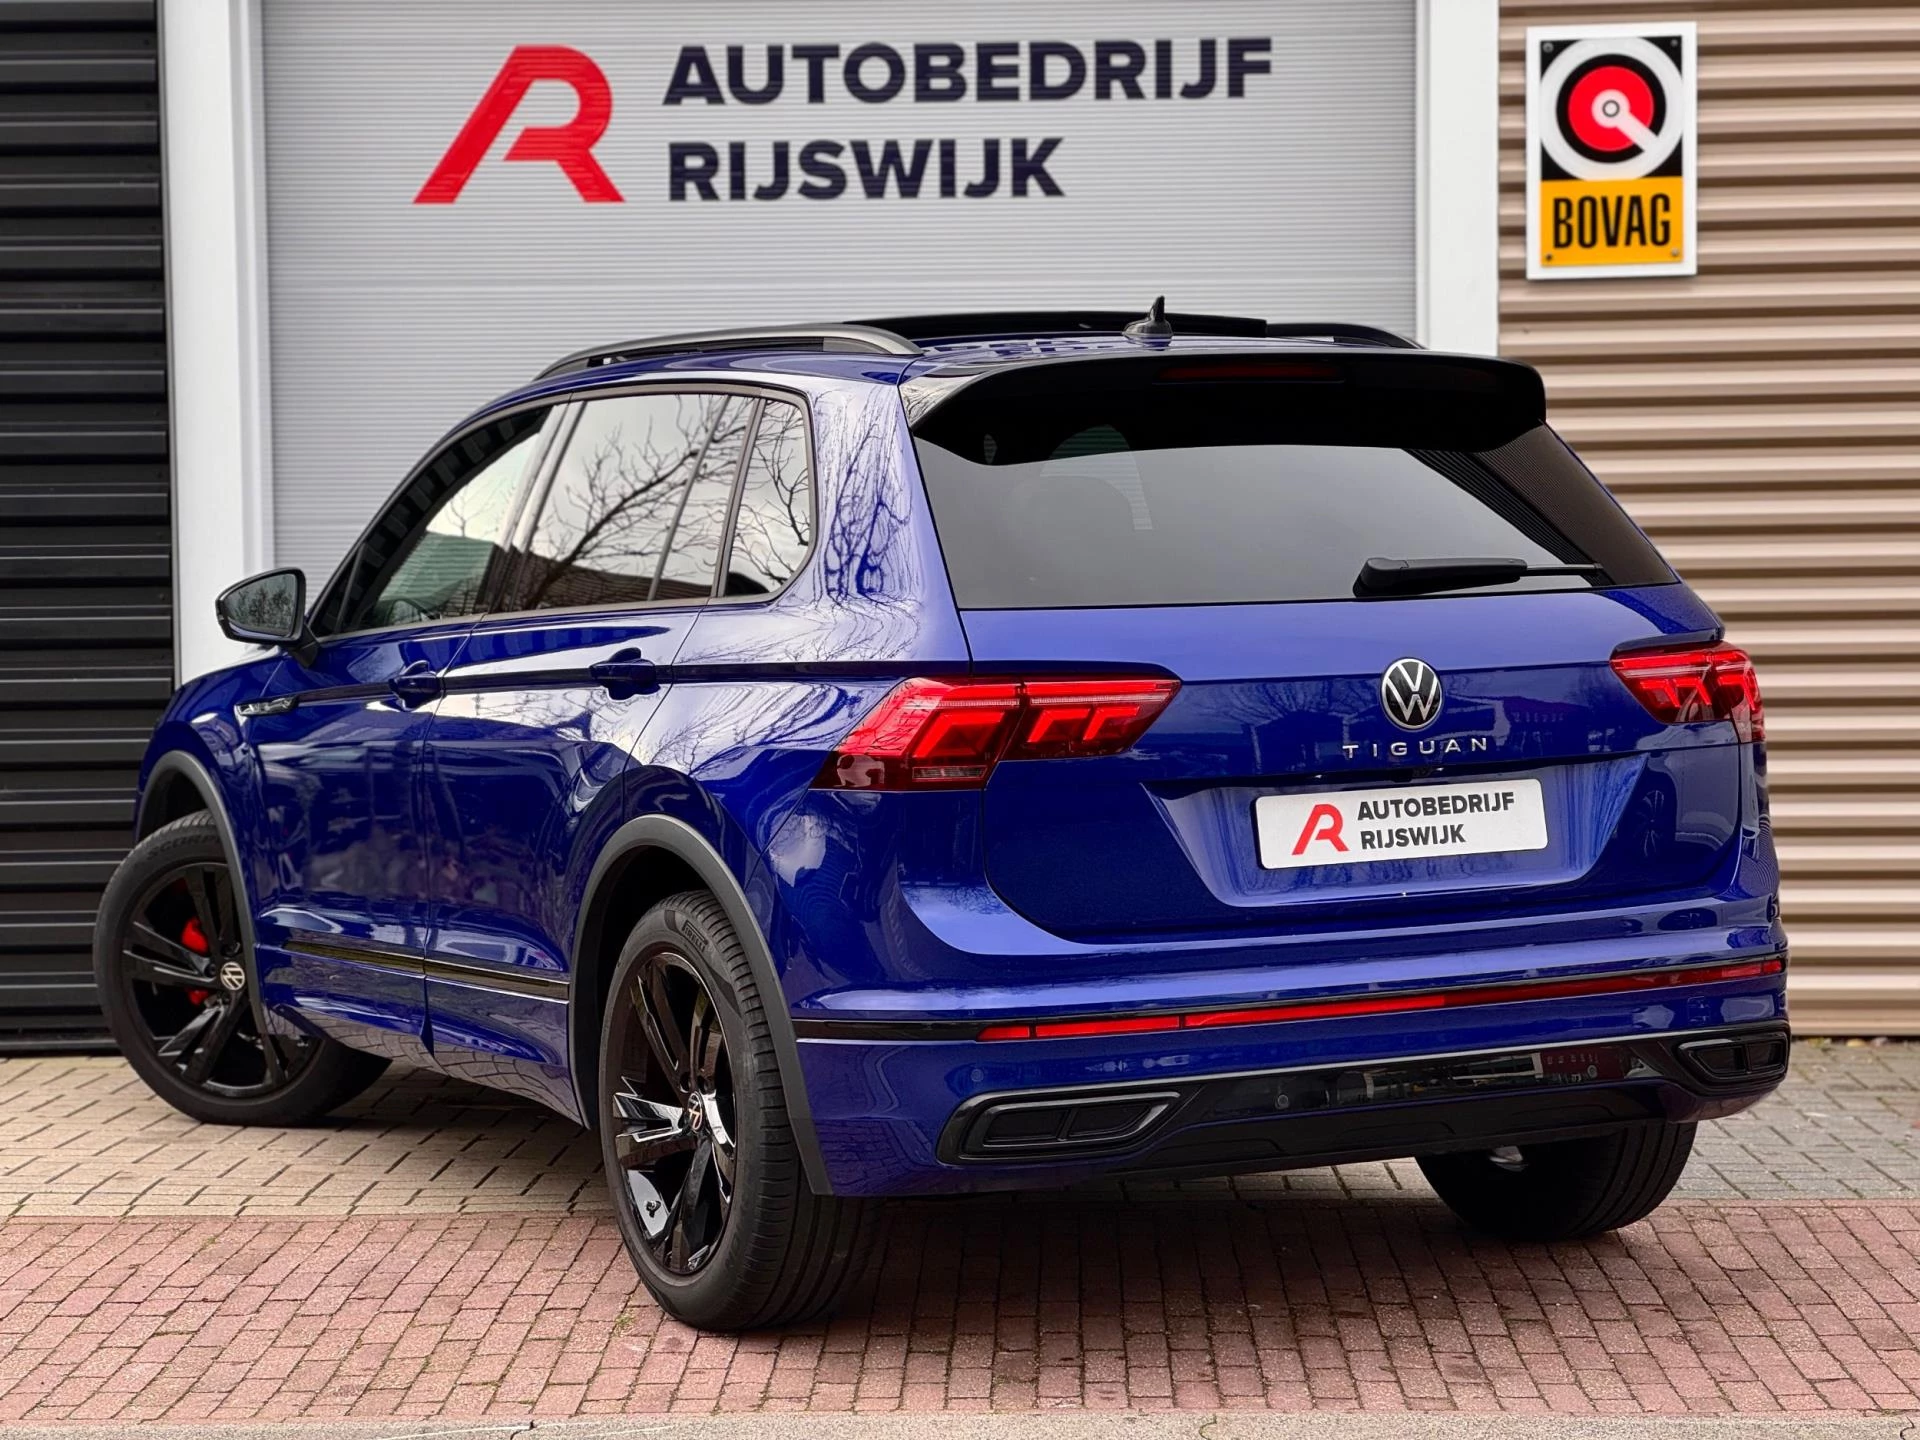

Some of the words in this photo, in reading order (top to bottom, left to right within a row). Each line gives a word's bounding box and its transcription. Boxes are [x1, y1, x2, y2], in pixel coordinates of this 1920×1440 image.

[662, 37, 1273, 105] AUTOBEDRIJF
[668, 137, 1066, 202] RIJSWIJK
[1553, 193, 1671, 249] BOVAG
[1342, 736, 1489, 760] TIGUAN
[1357, 791, 1516, 821] AUTOBEDRIJF
[1360, 823, 1467, 850] RIJSWIJK
